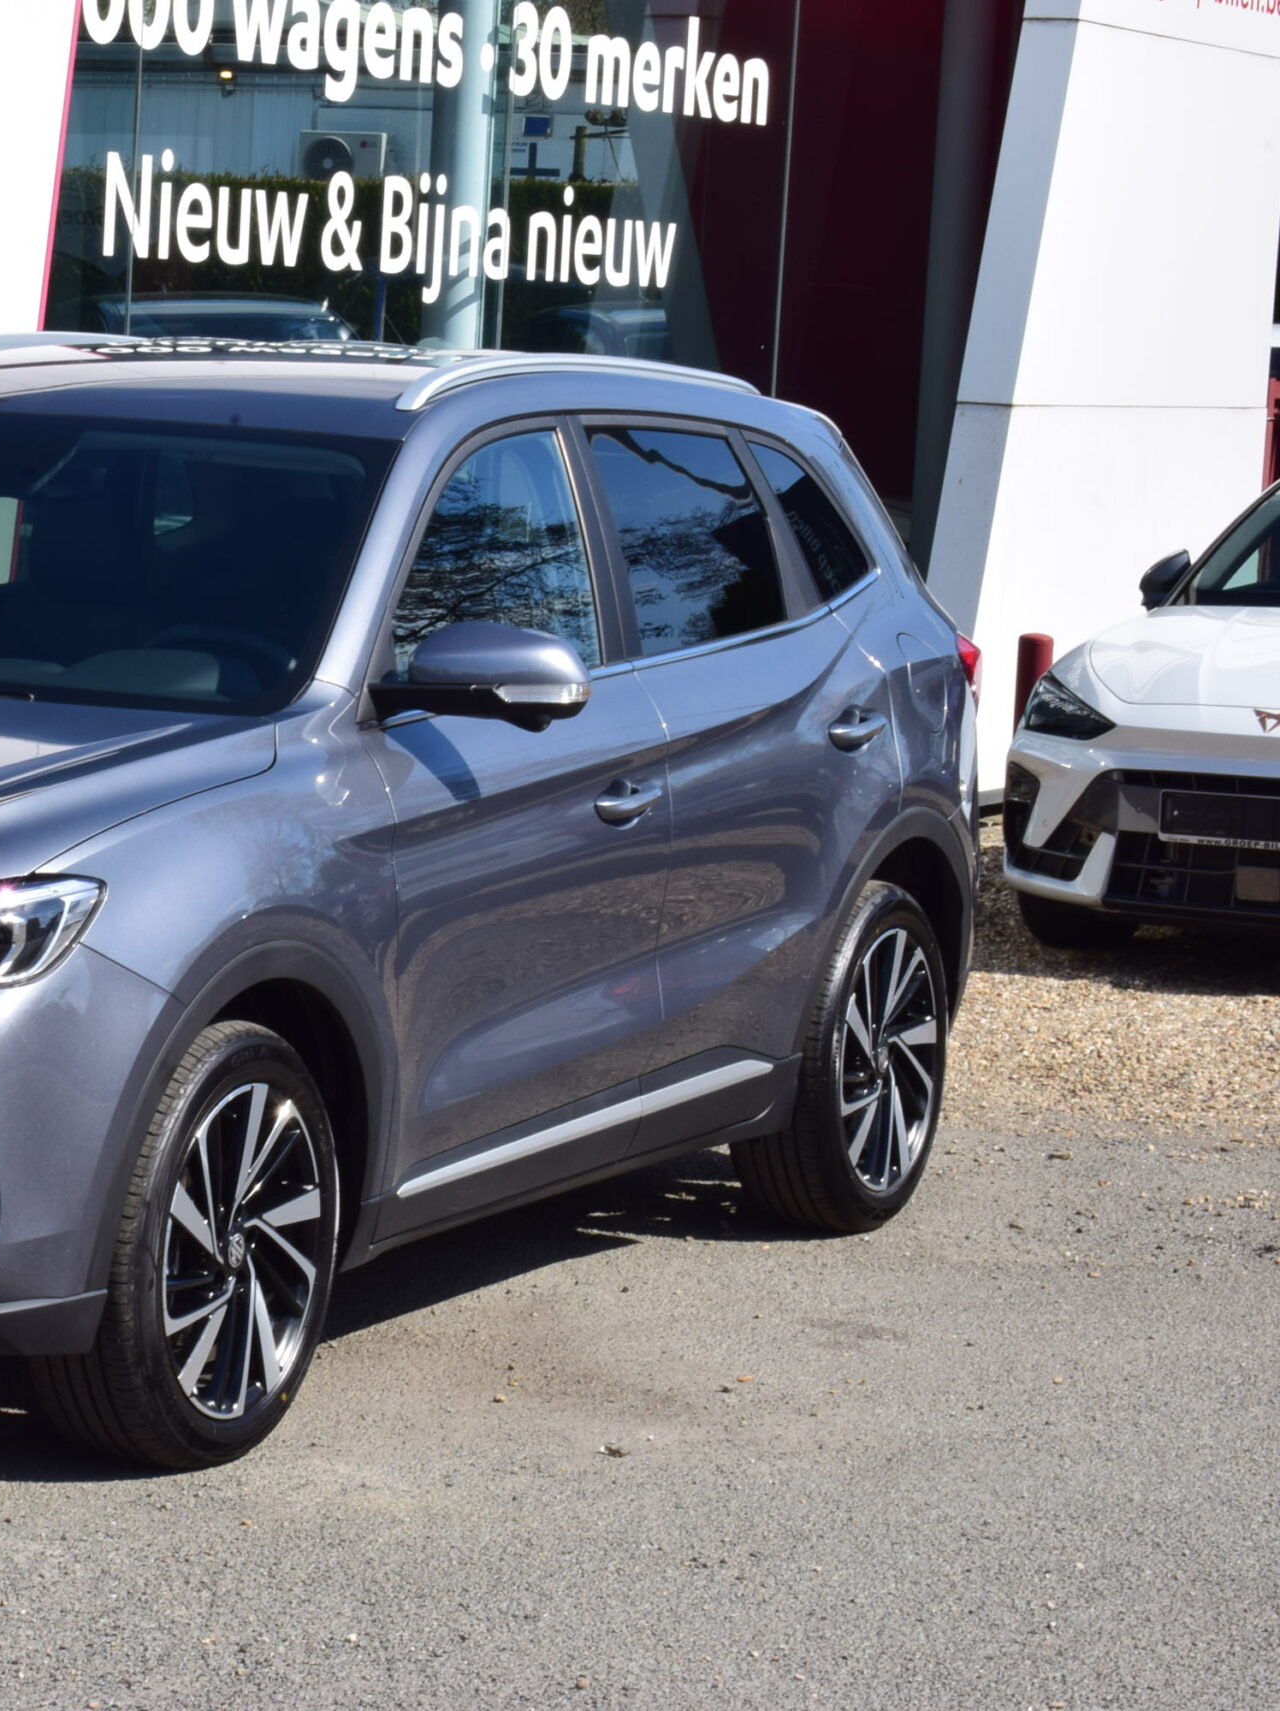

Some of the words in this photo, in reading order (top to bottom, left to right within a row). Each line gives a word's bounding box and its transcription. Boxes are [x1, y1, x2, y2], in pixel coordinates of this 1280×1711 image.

[233, 0, 464, 103] wagens
[509, 2, 572, 100] 30
[584, 16, 770, 127] merken
[101, 149, 309, 268] Nieuw
[320, 170, 364, 273] &
[379, 173, 509, 305] Bijna
[525, 185, 678, 290] nieuw
